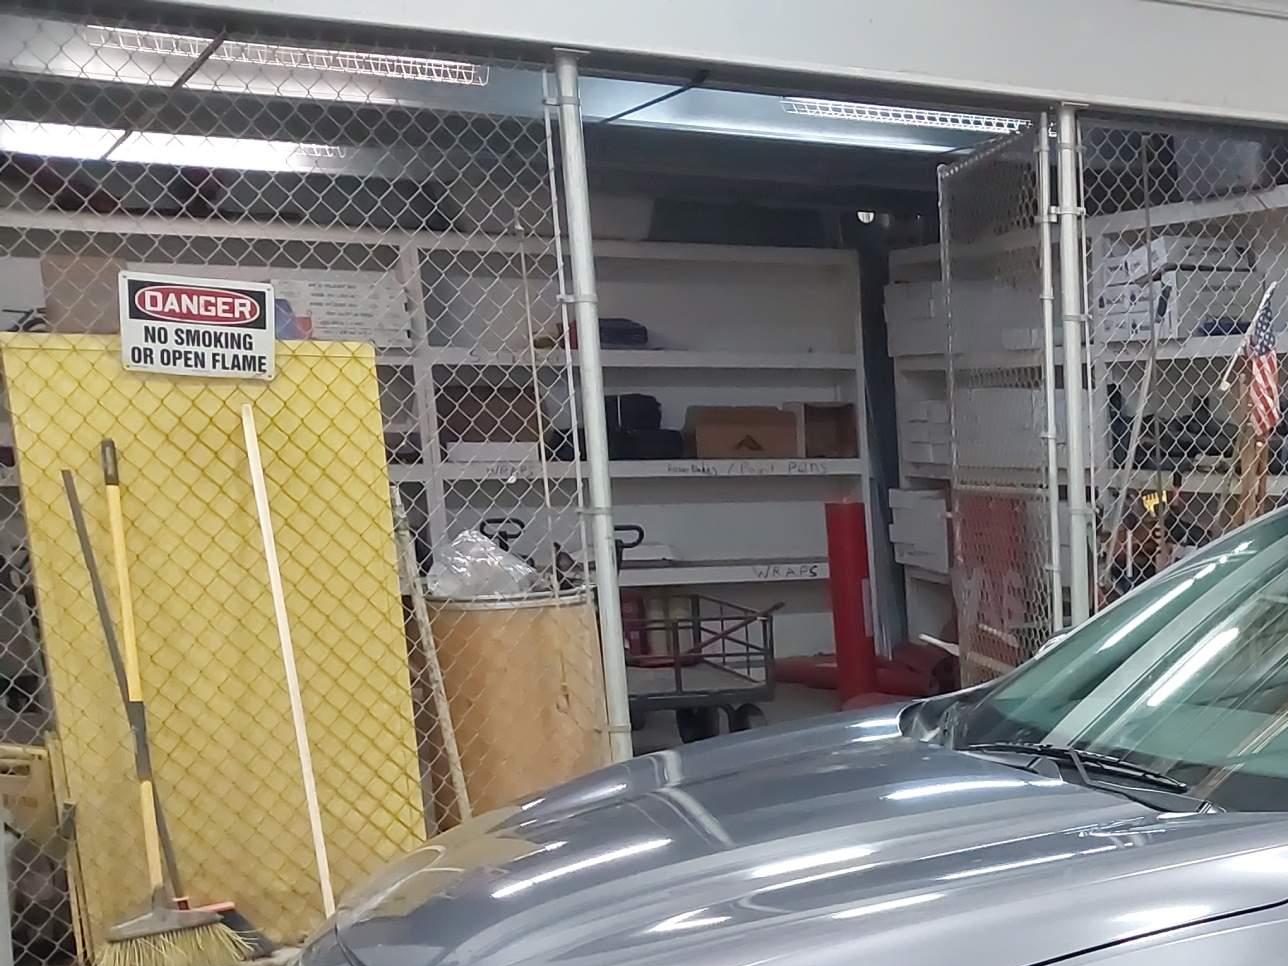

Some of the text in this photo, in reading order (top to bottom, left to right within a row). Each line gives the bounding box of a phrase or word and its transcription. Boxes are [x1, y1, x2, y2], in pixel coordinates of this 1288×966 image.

[144, 290, 252, 319] DANGER
[143, 325, 254, 351] NO SMOKING
[131, 346, 268, 373] OR OPEN FLAME
[752, 565, 818, 578] WRAPS
